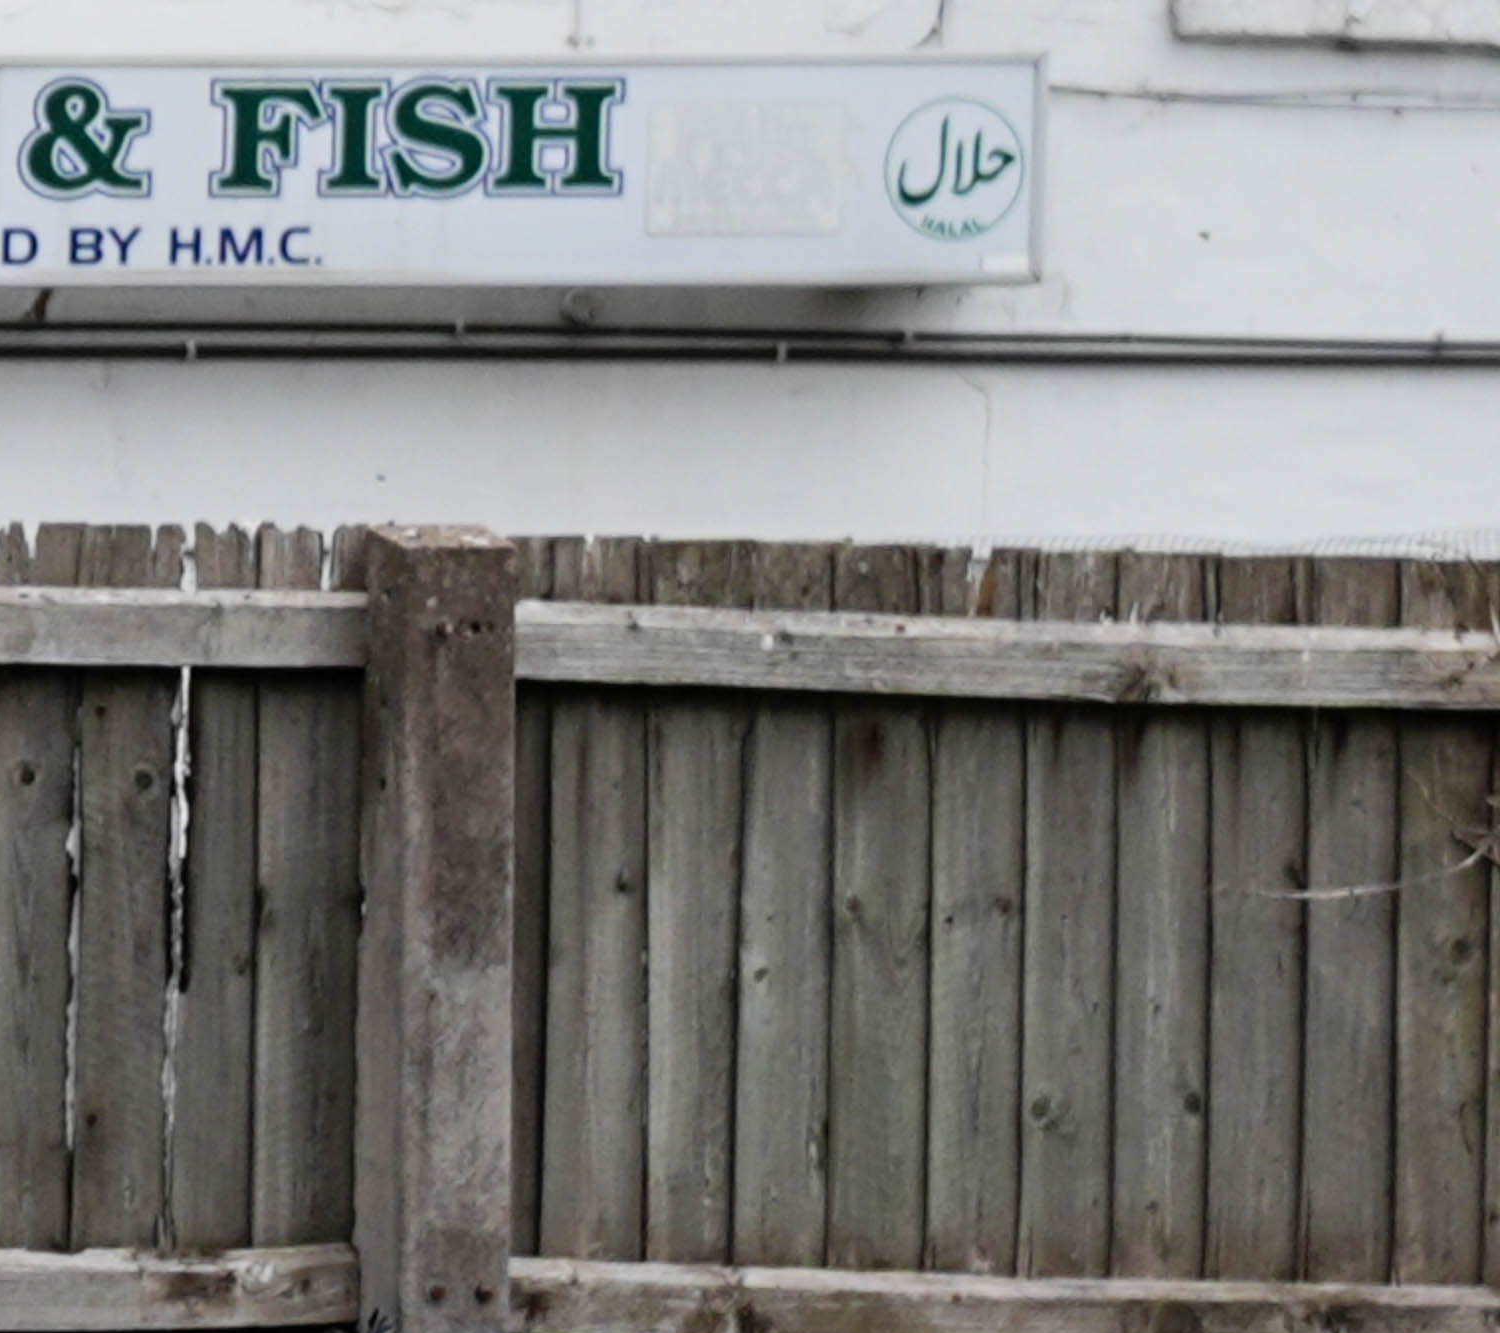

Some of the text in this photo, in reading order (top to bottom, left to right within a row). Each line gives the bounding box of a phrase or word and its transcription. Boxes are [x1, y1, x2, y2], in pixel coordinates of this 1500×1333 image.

[17, 76, 153, 200] &
[208, 76, 626, 199] FISH
[896, 114, 1017, 208] حلال
[69, 227, 140, 265] BY
[169, 227, 322, 265] H.M.C.
